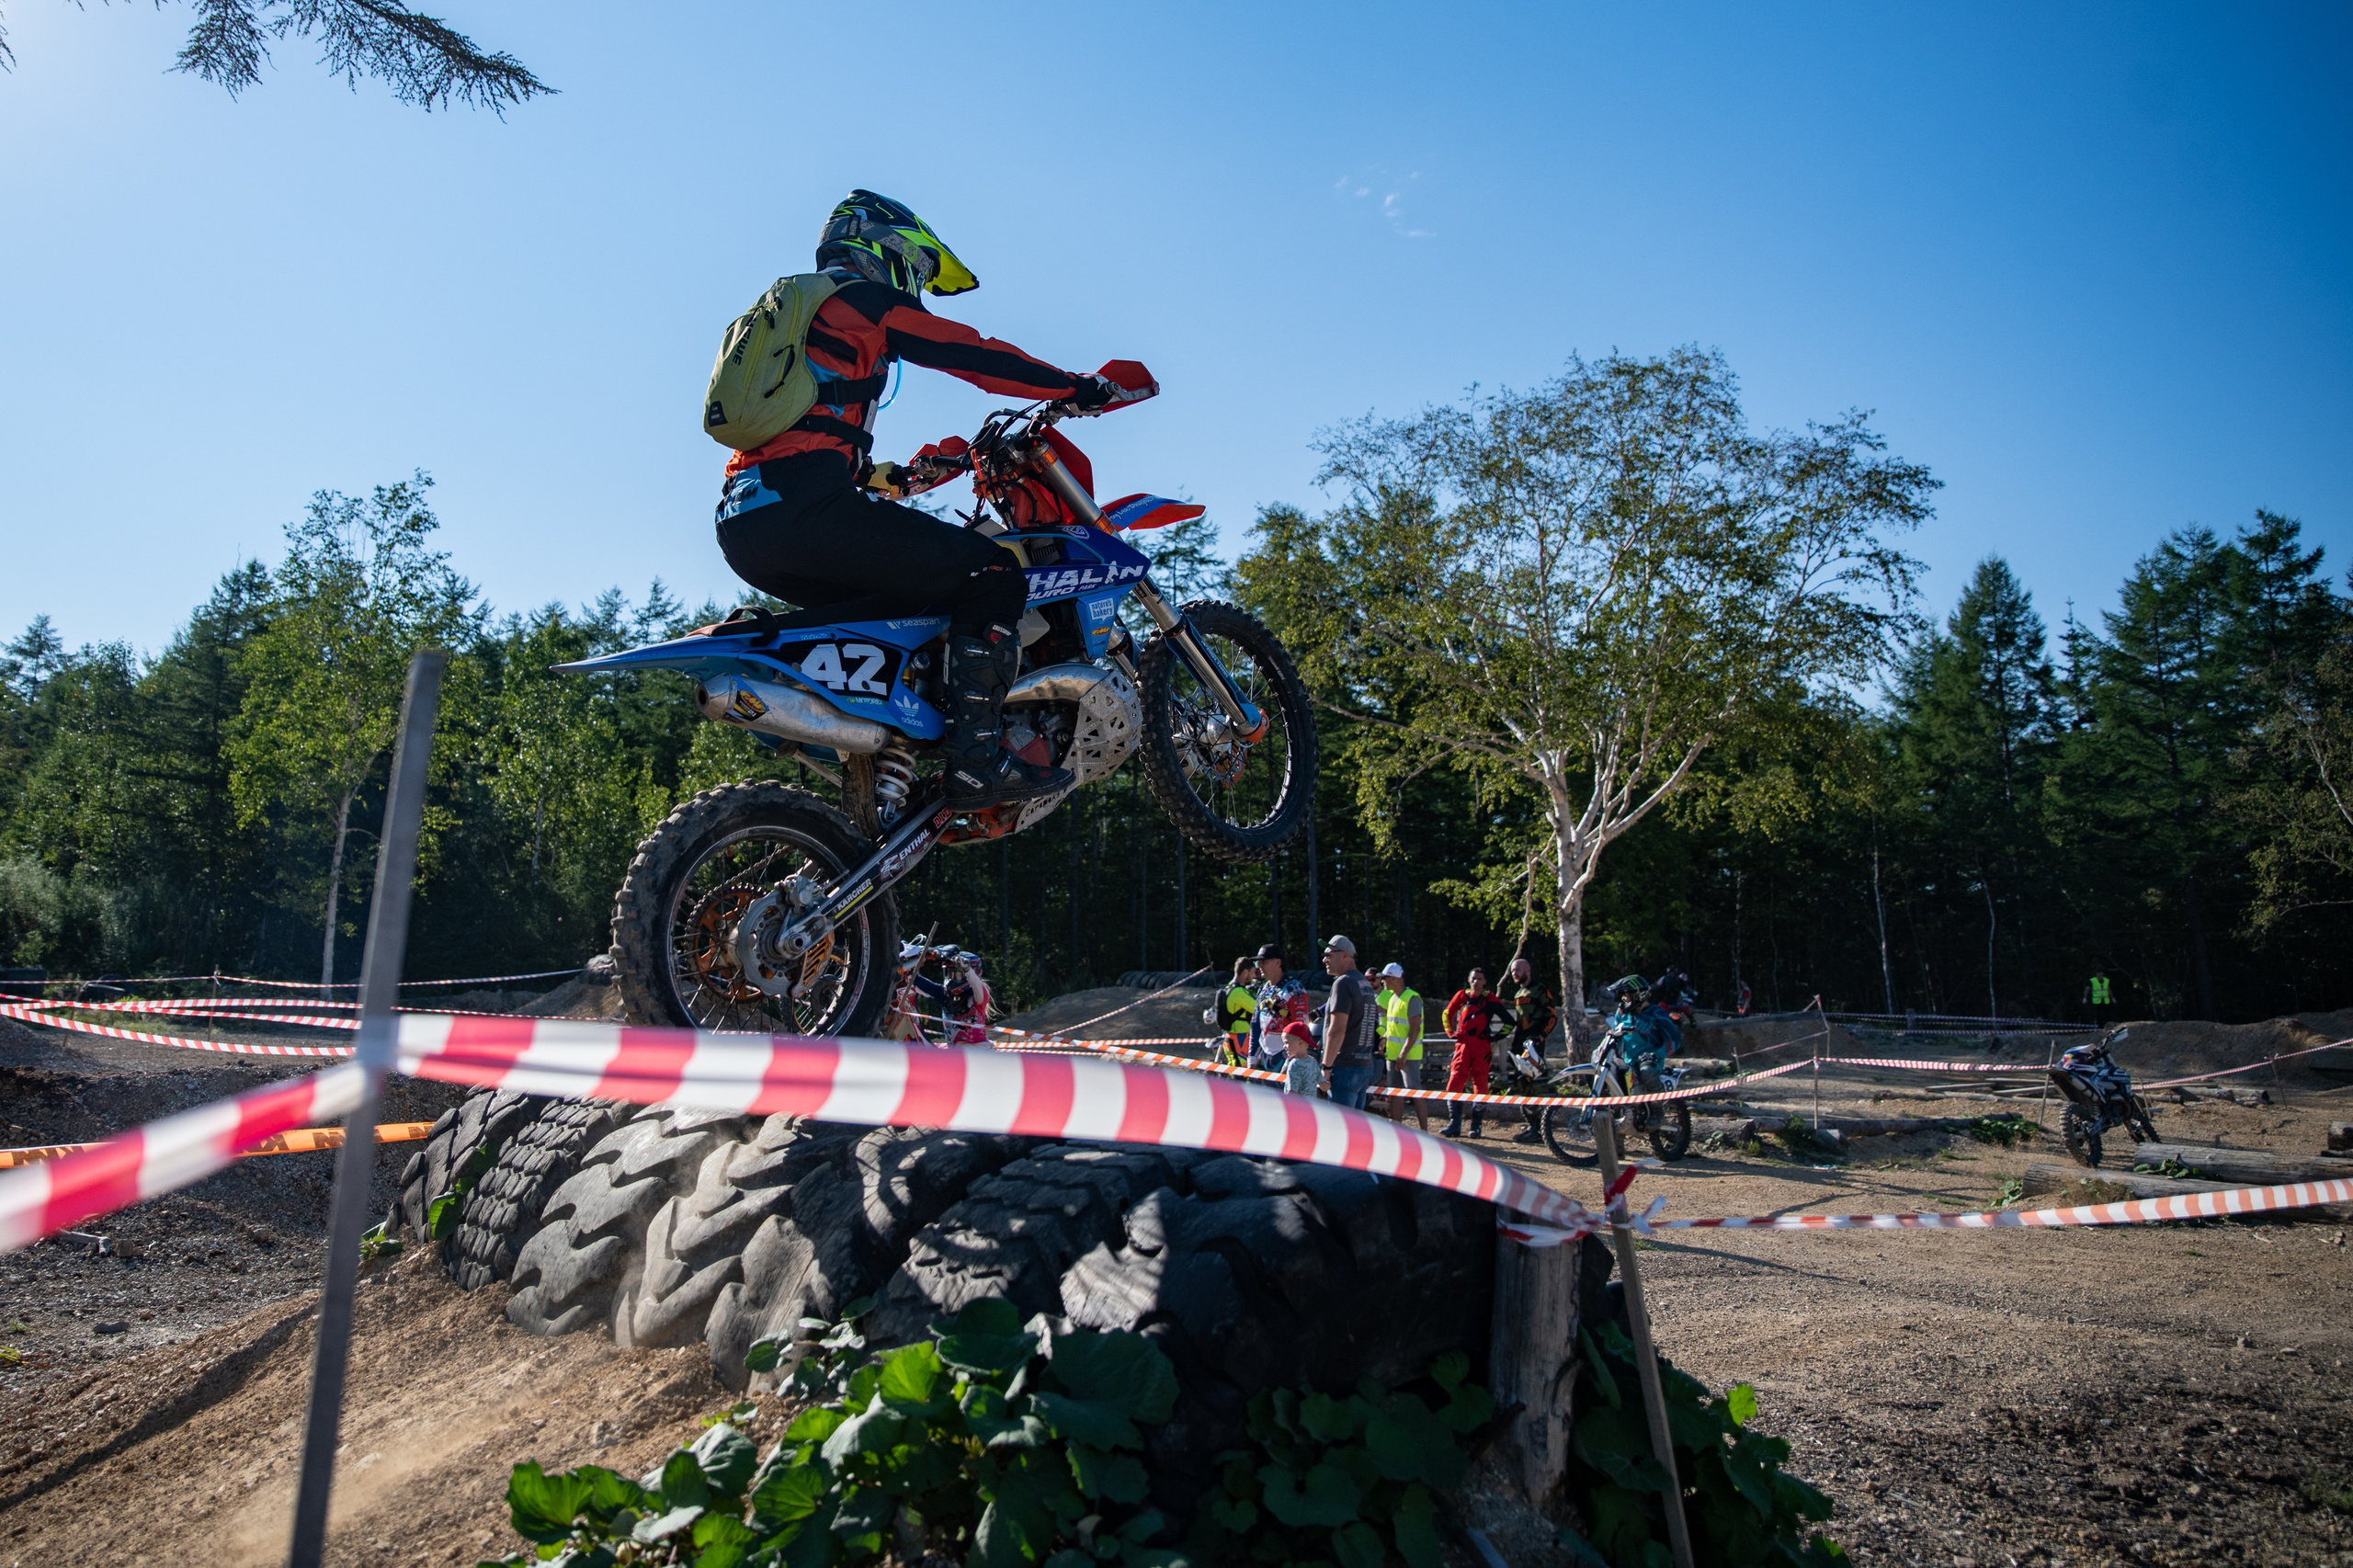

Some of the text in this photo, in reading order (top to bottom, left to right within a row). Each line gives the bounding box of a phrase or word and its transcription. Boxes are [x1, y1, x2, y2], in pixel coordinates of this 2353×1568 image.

[1093, 608, 1113, 618] bakery
[902, 618, 940, 627] seaspan
[801, 643, 888, 696] 42
[901, 716, 924, 728] adidas
